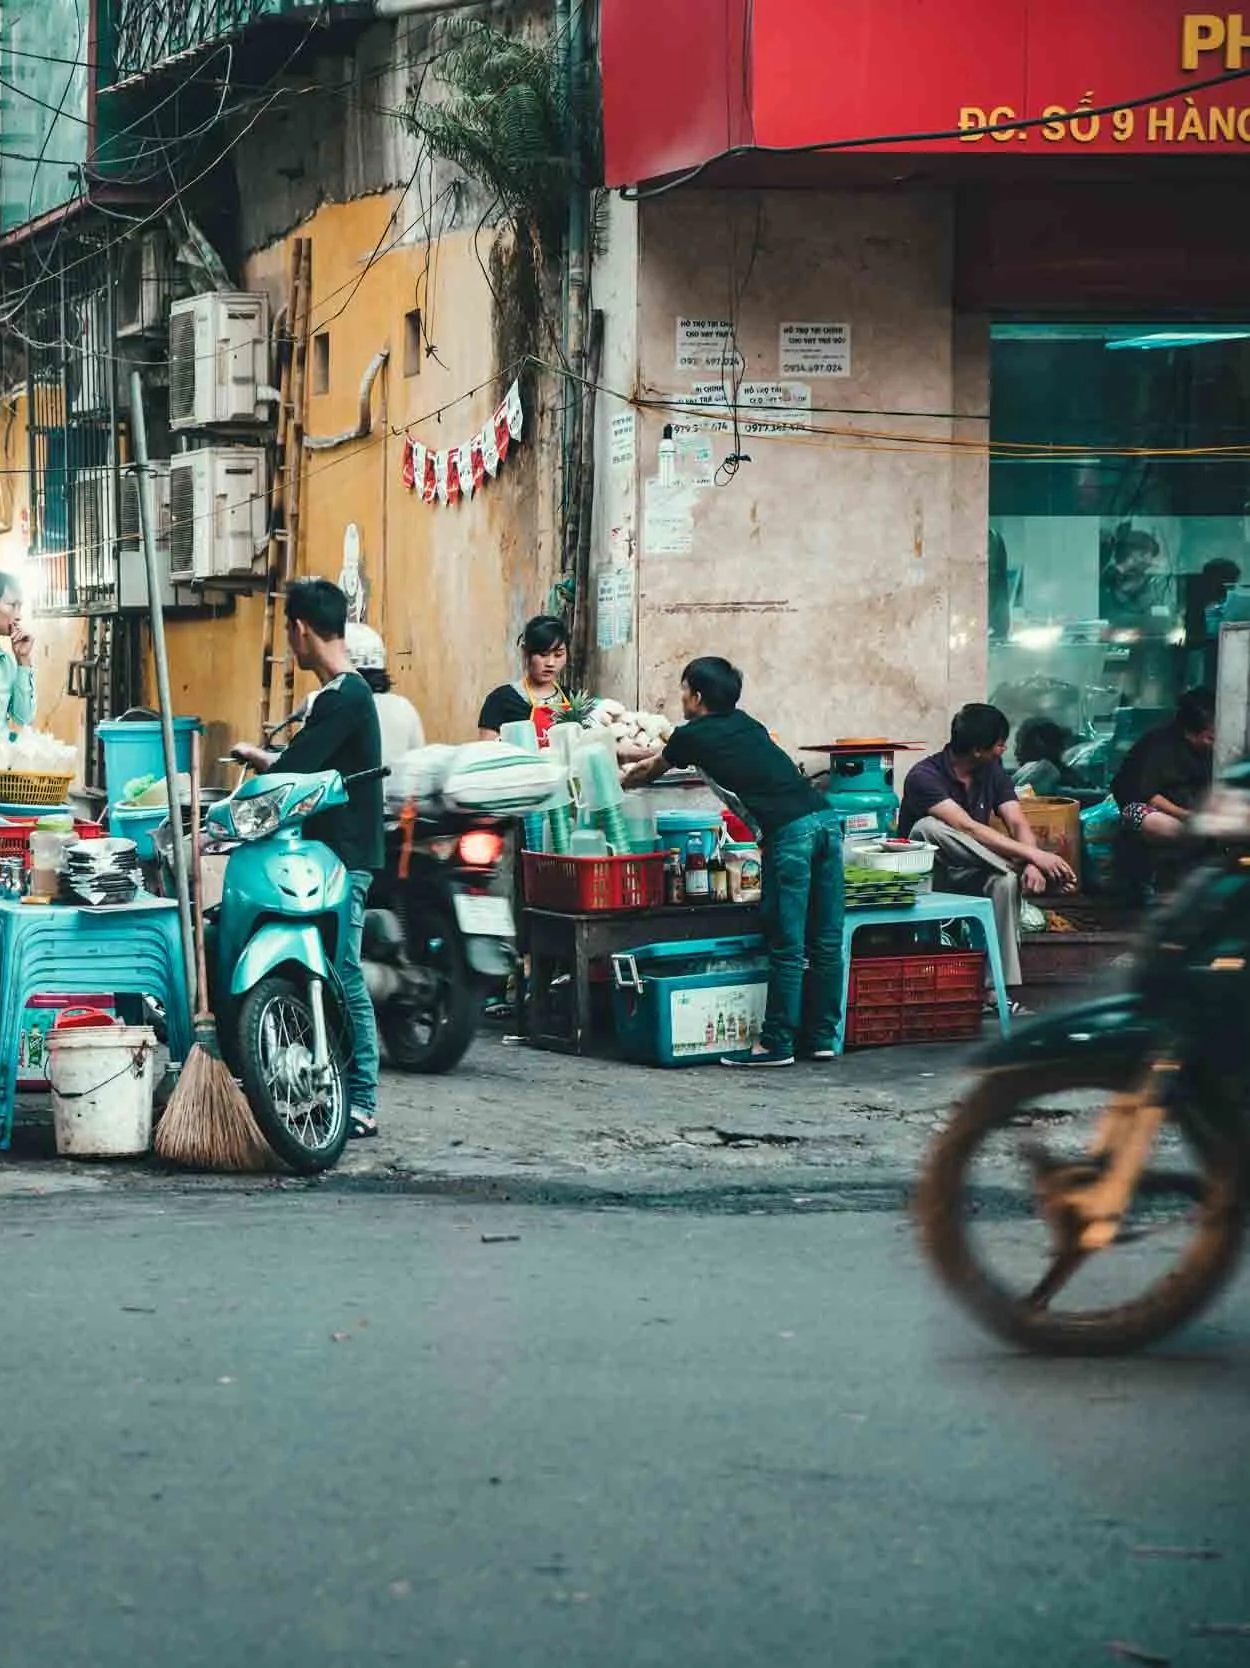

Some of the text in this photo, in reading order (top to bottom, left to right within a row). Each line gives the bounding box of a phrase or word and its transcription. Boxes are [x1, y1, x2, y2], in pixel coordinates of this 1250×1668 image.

[958, 106, 1027, 142] ĐC.
[1042, 90, 1100, 142] SỐ
[1112, 108, 1134, 141] 9
